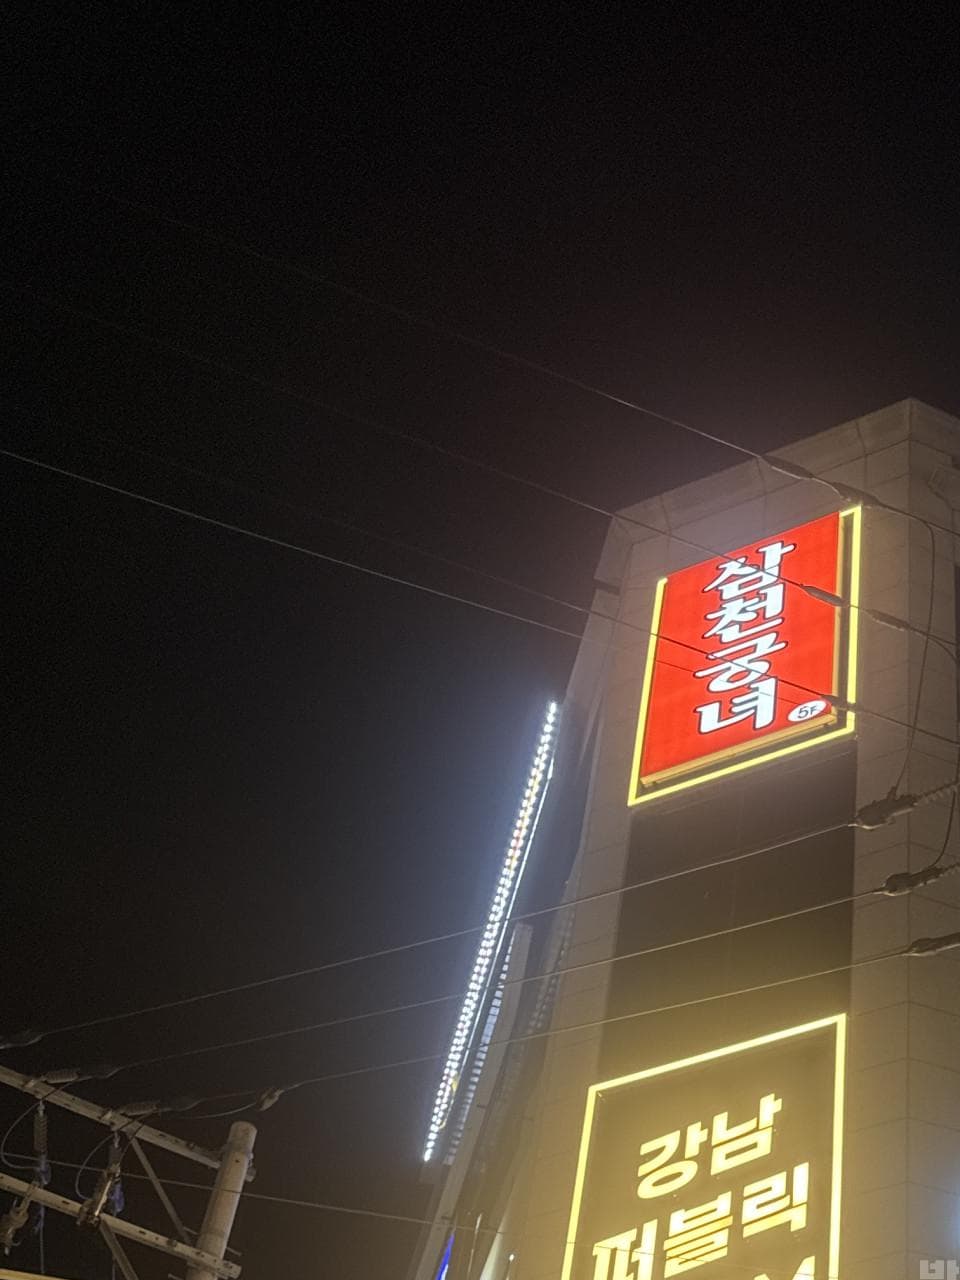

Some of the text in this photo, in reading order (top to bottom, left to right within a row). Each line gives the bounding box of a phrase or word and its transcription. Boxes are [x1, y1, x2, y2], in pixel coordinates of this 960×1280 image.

[694, 540, 794, 735] 삼천궁녀
[797, 703, 820, 721] 5F
[637, 1093, 782, 1199] 강남
